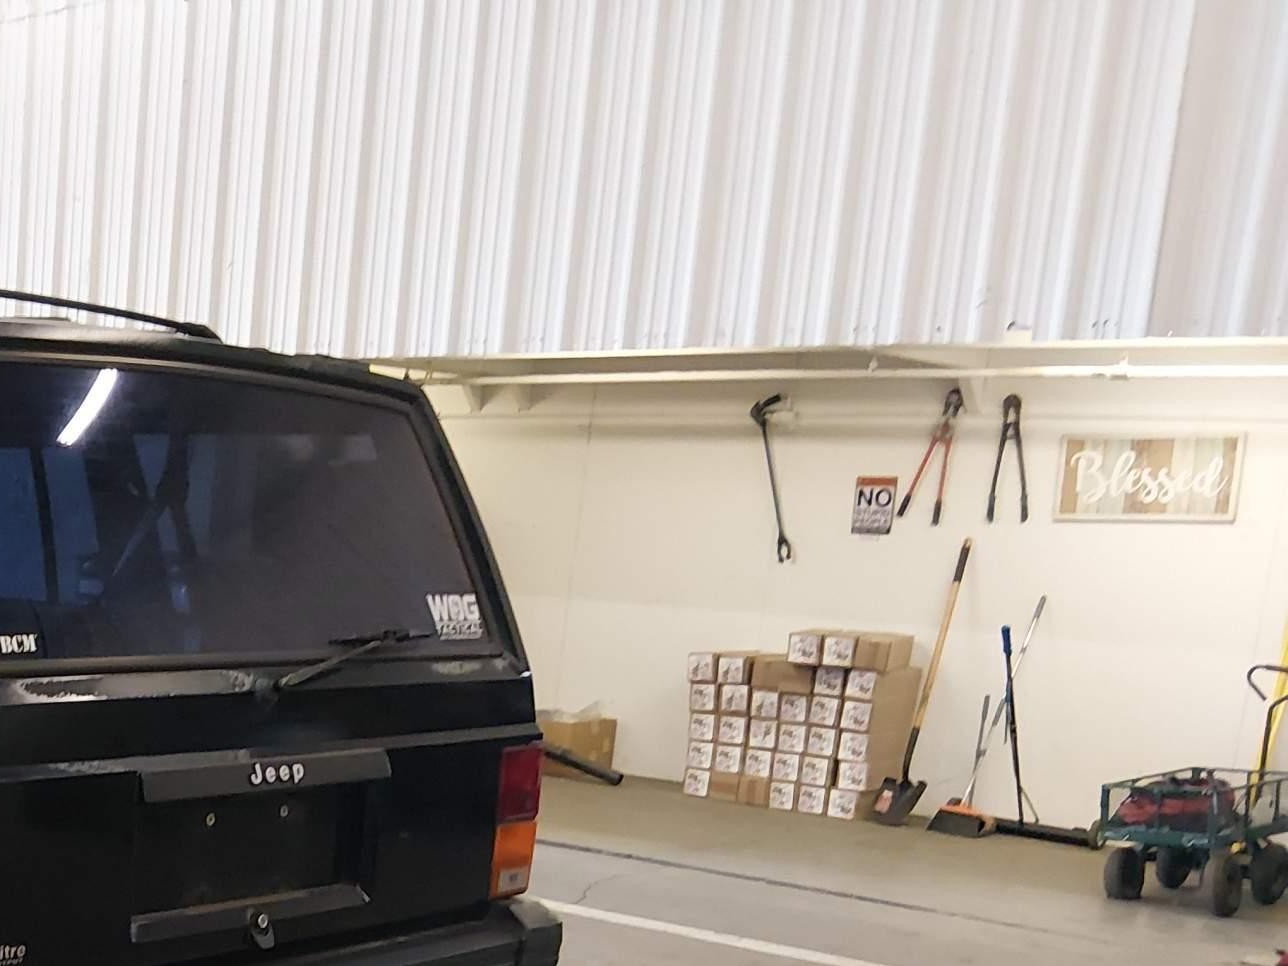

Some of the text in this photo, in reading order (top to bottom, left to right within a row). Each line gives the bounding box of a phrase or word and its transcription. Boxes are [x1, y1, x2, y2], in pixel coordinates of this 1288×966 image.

[1070, 450, 1229, 505] Blessed
[857, 488, 892, 508] NO
[250, 762, 305, 785] Jeep
